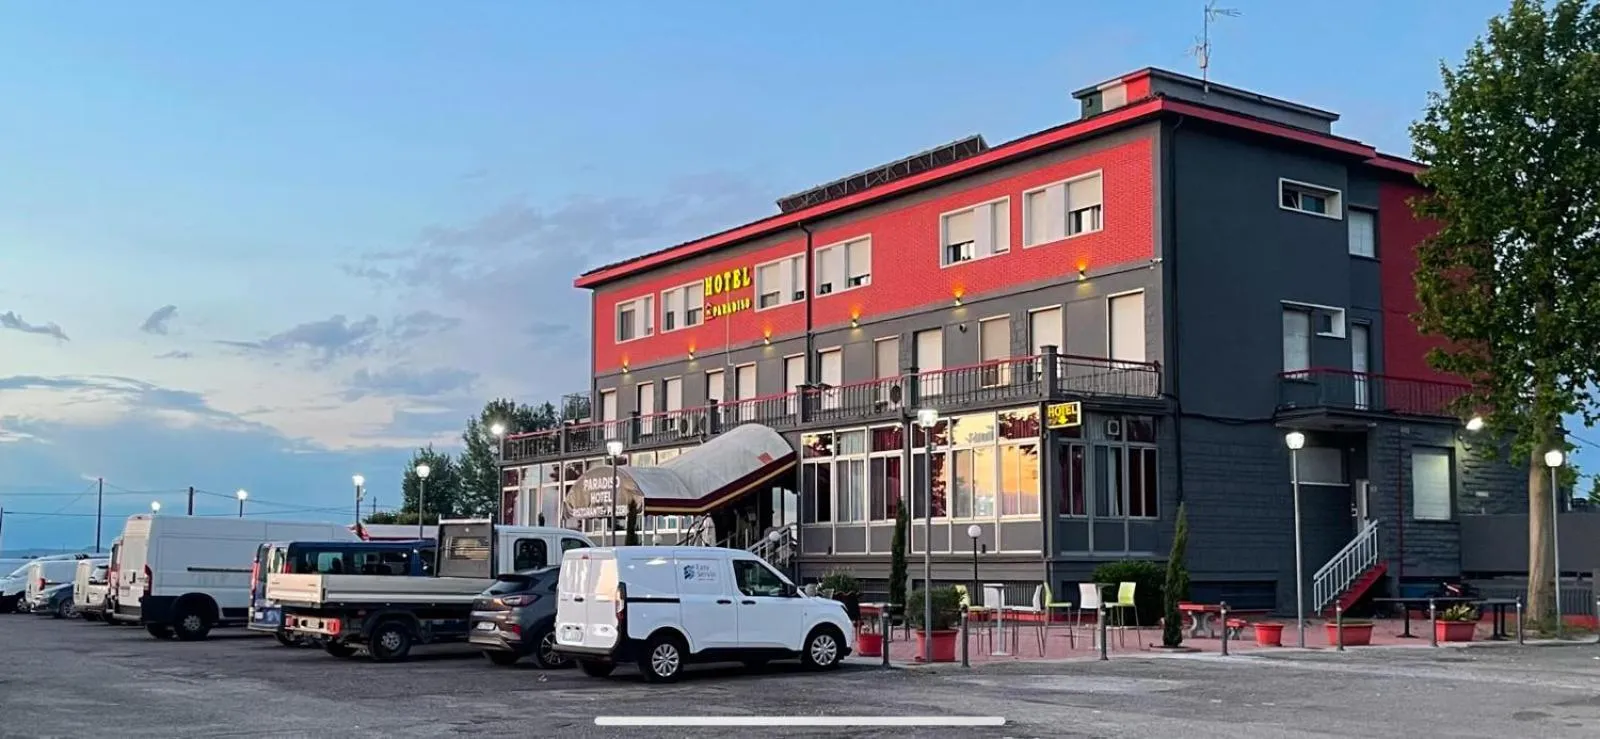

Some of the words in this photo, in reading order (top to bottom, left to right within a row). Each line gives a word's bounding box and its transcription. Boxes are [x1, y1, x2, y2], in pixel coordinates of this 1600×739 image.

[705, 266, 751, 296] HOTEL
[713, 298, 750, 316] PARADISO
[1048, 404, 1077, 417] HOTEL
[583, 476, 620, 491] PARADISO
[591, 491, 613, 504] HOTEL
